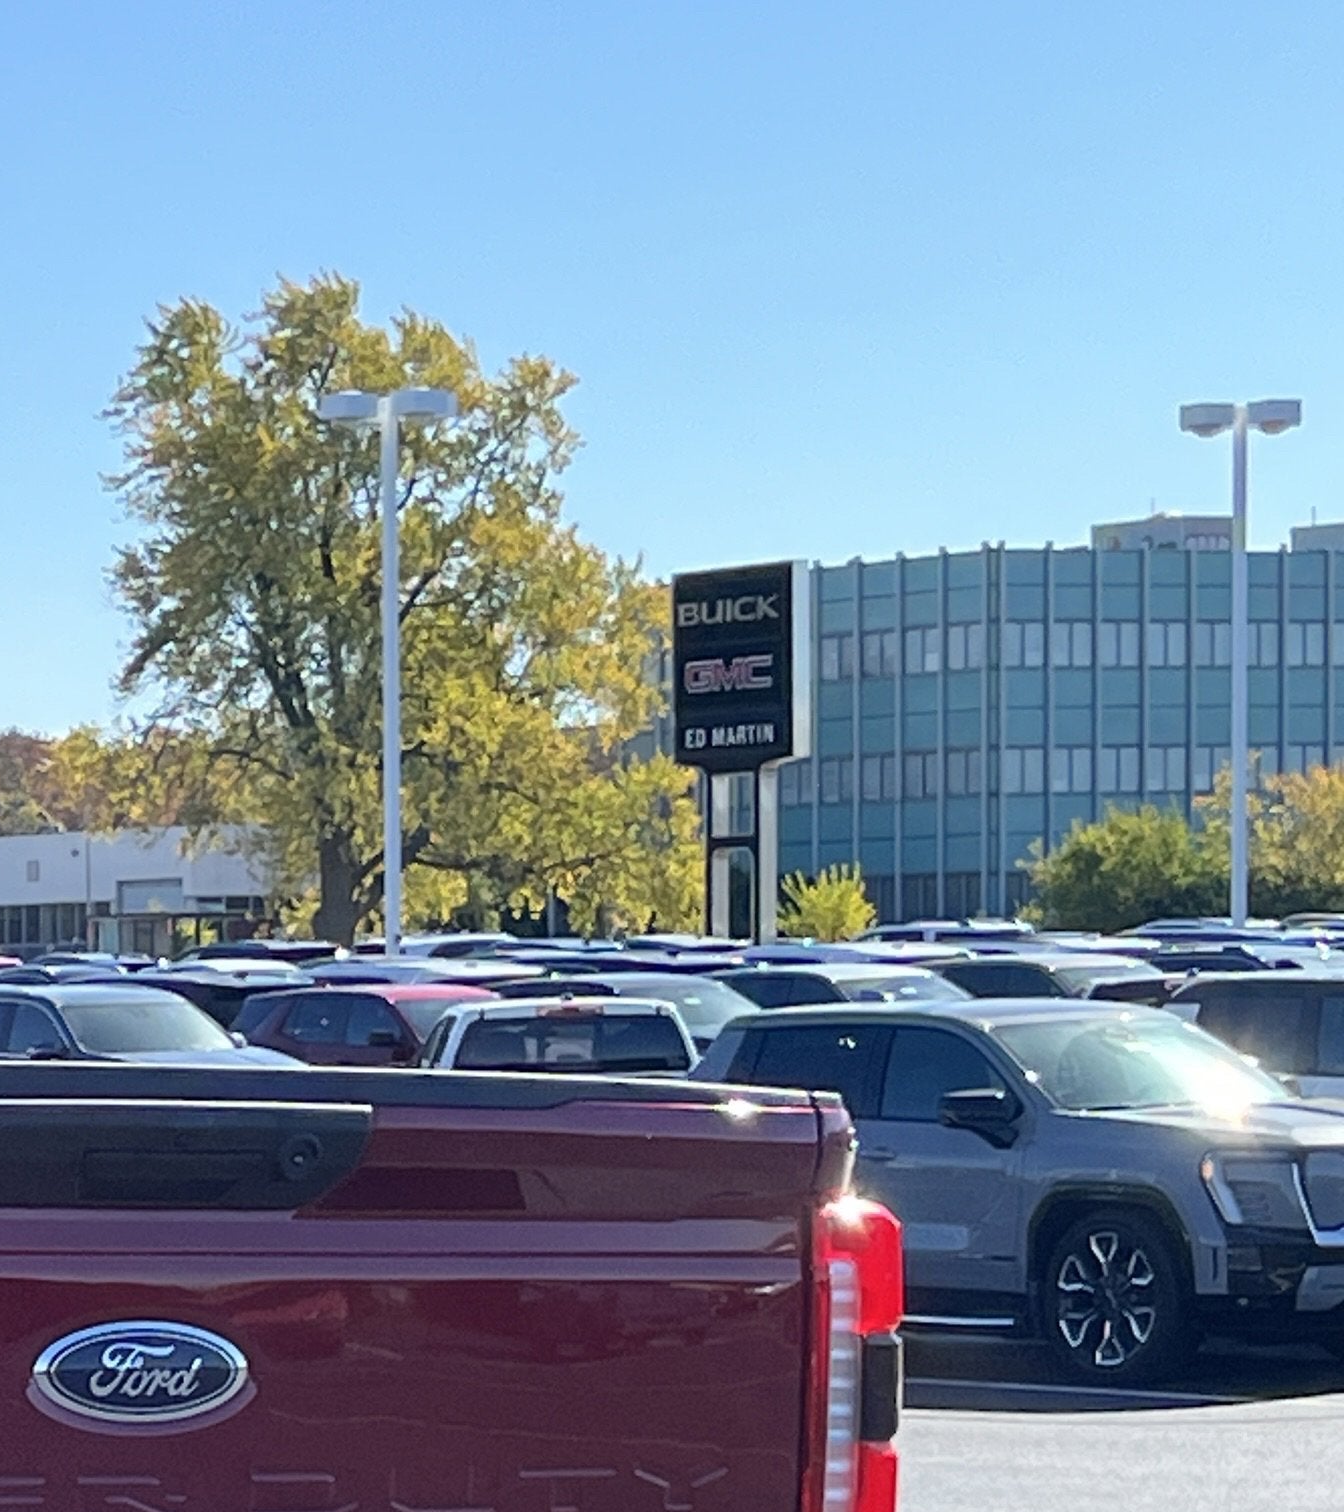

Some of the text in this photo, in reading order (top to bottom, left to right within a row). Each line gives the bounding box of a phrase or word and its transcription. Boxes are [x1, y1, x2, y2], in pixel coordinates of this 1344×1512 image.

[676, 593, 780, 627] BUICK
[683, 654, 774, 694] GMC
[684, 723, 775, 748] ED MARTIN
[89, 1342, 203, 1397] Ford
